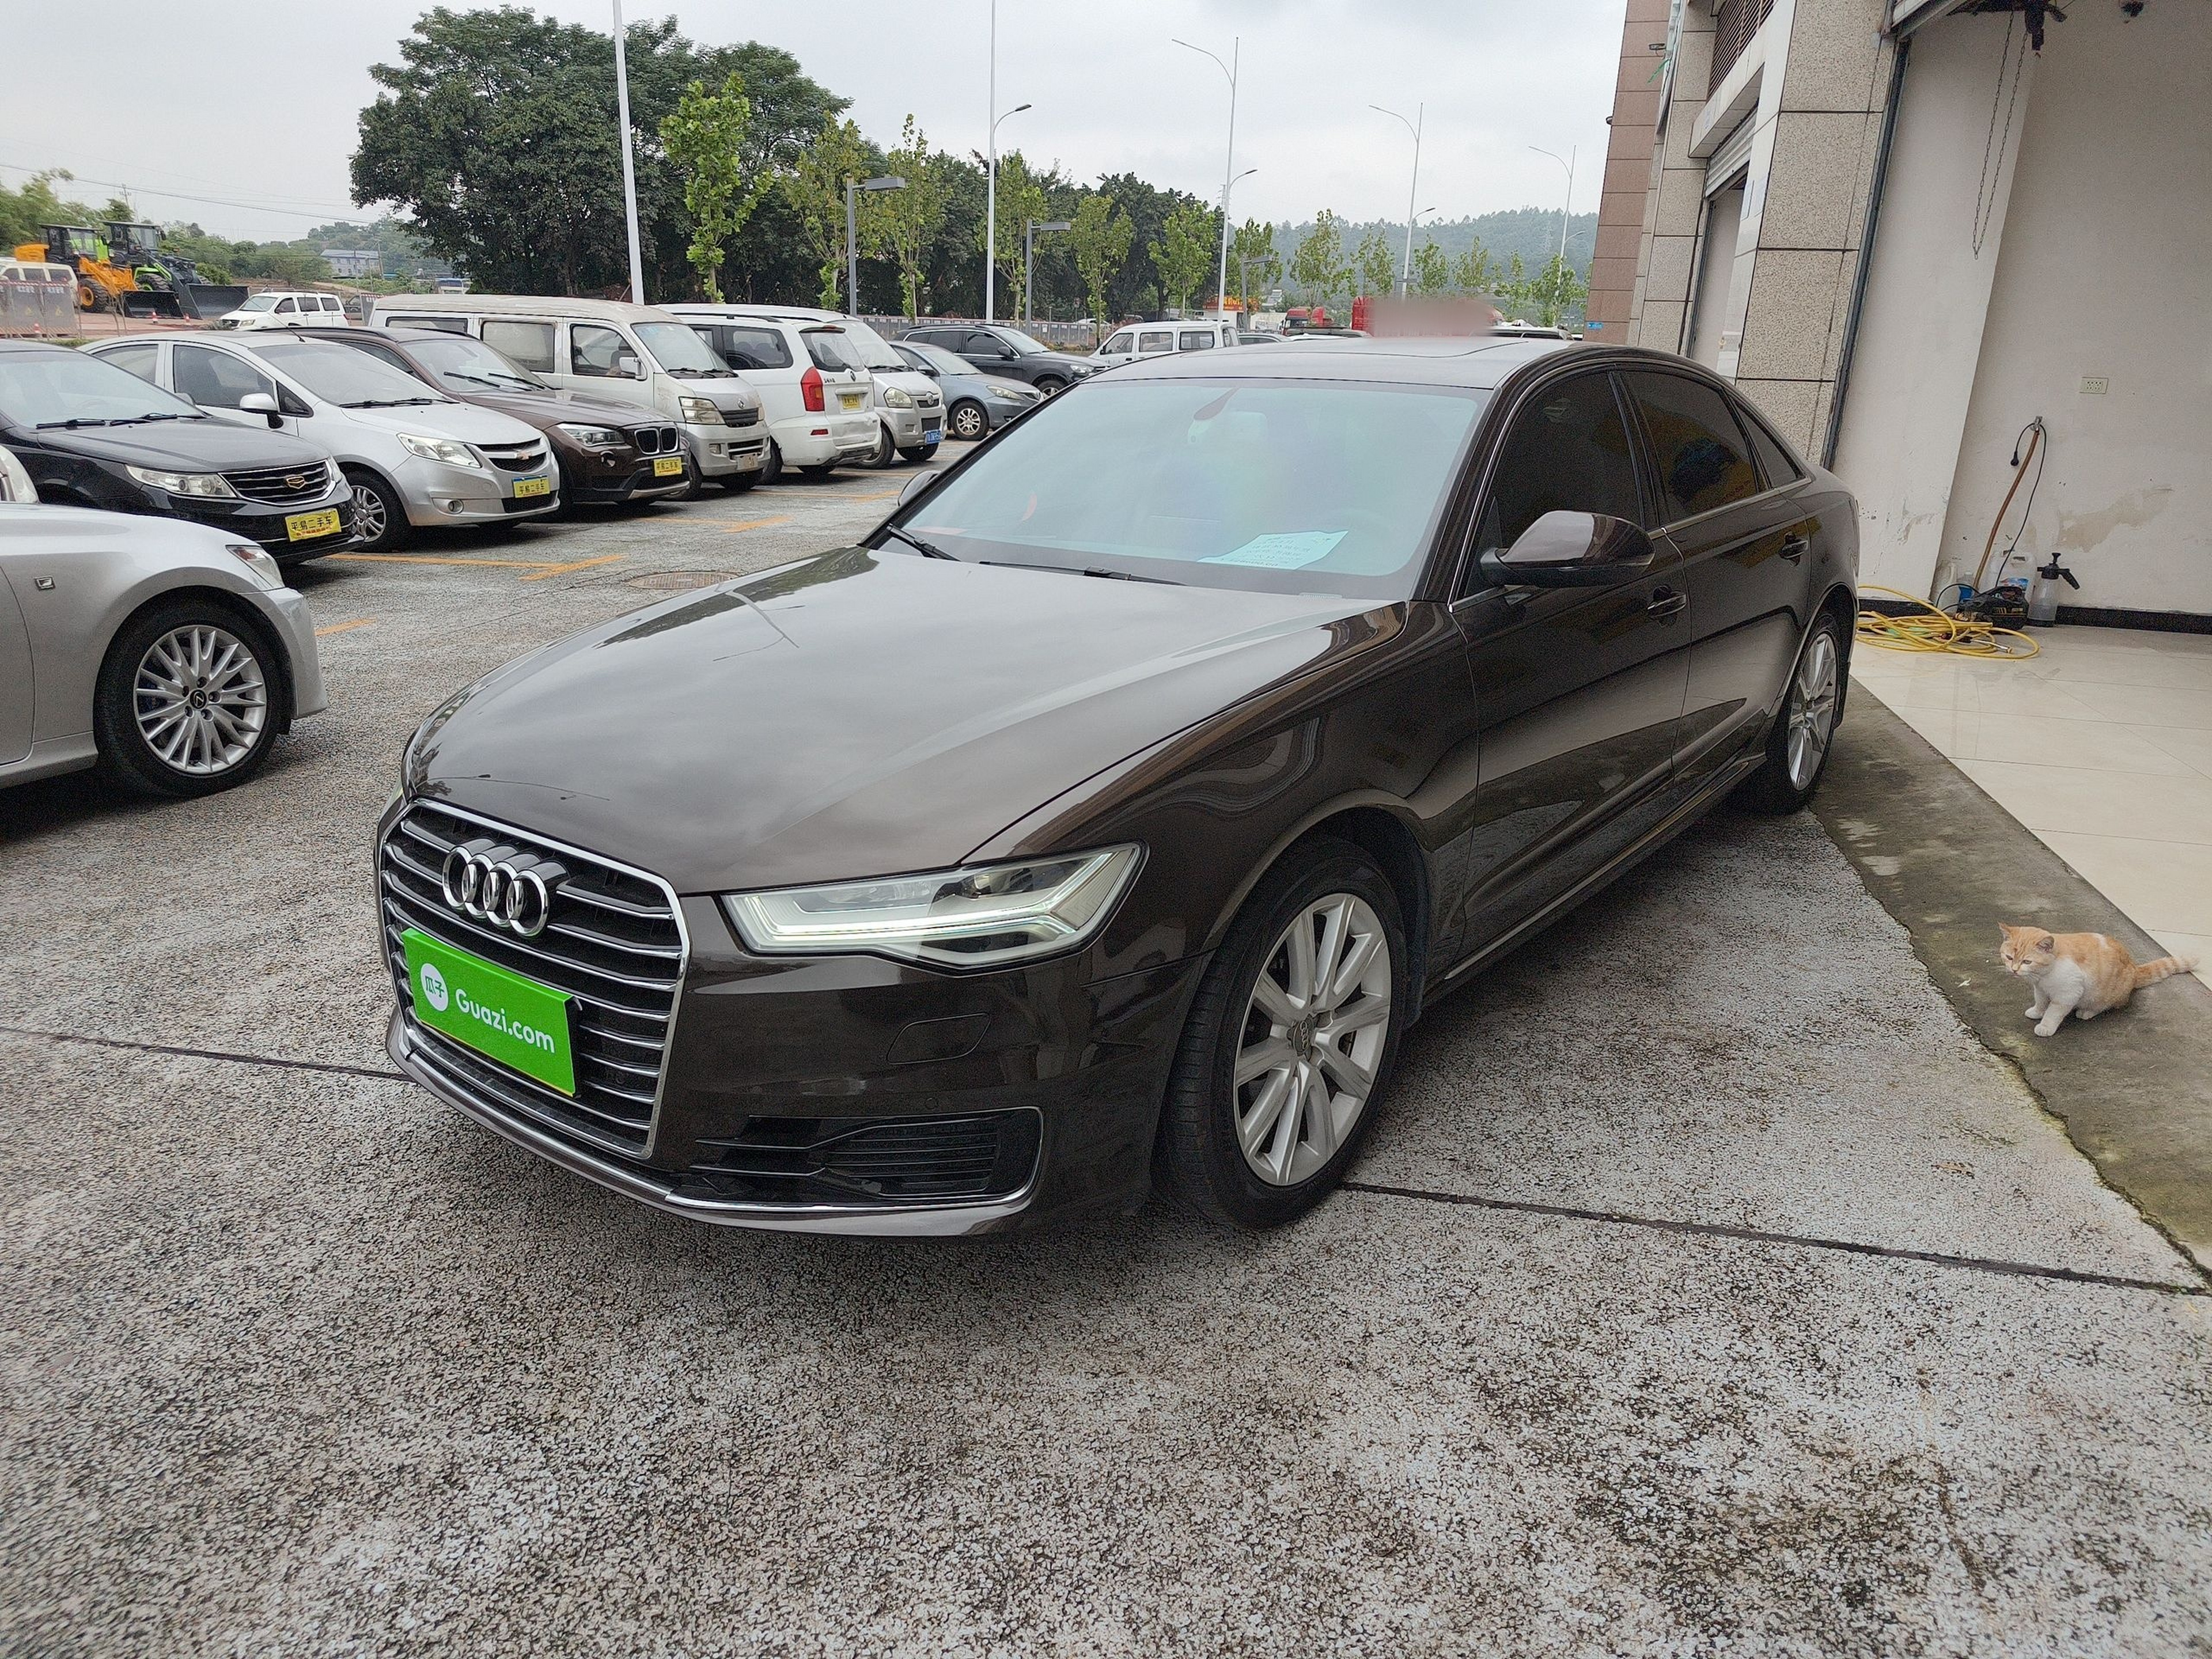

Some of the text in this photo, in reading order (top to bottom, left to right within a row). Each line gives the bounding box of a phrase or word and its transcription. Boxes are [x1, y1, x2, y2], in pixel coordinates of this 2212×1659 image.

[291, 516, 332, 531] 平易二手车
[425, 975, 444, 998] 瓜子
[456, 988, 555, 1054] Guazi.com
